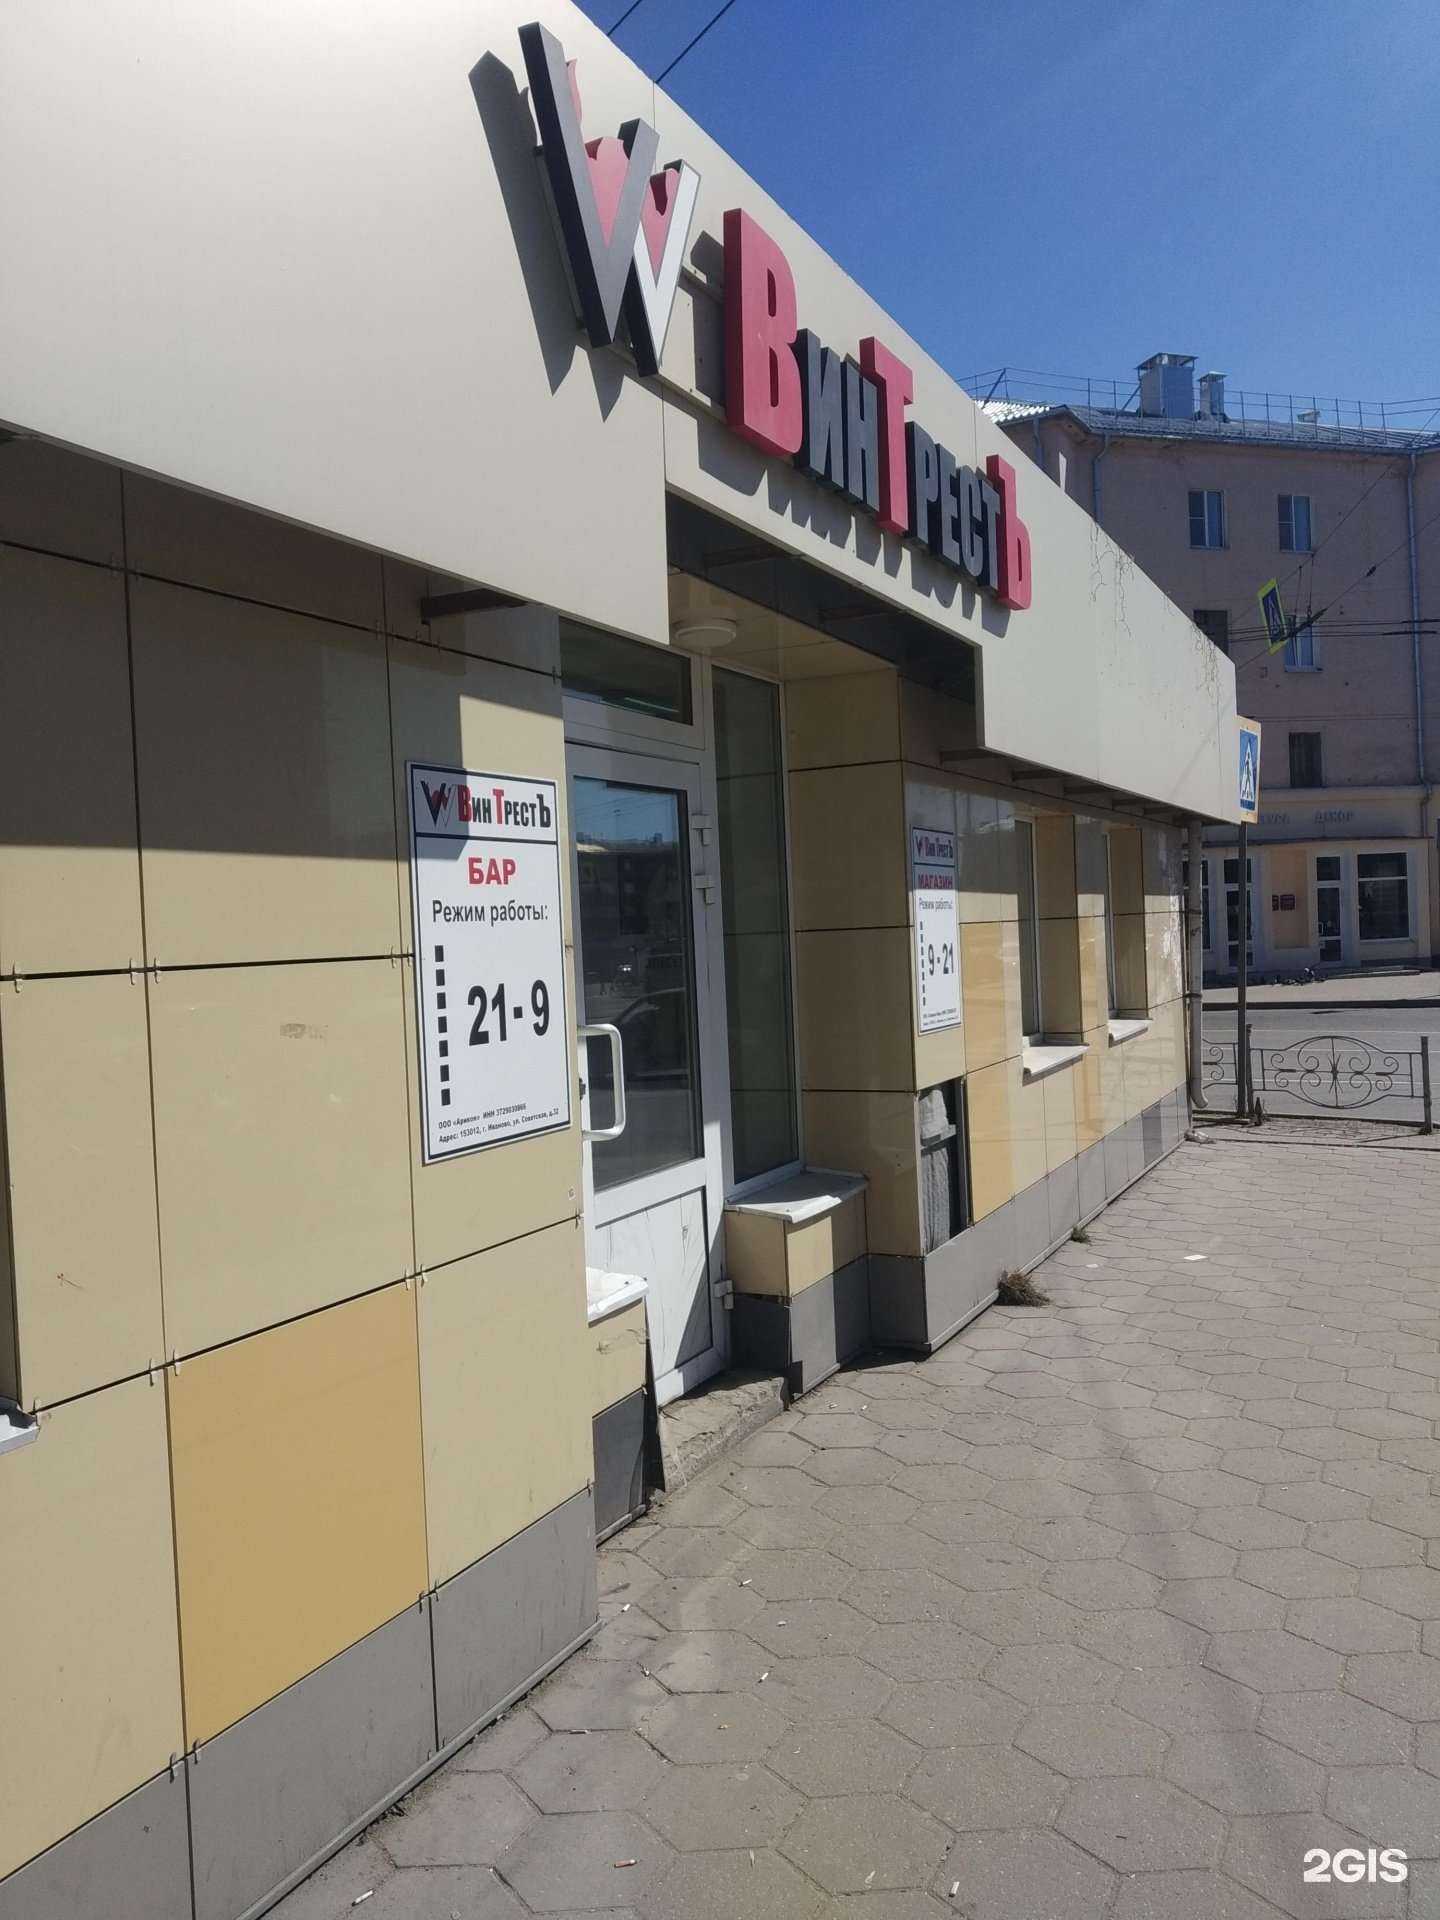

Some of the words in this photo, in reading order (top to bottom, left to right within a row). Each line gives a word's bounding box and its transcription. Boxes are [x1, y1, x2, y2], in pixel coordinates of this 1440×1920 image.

[468, 857, 516, 885] БАР
[918, 873, 953, 889] МАГАЗИН
[432, 900, 485, 922] Режим
[491, 900, 549, 926] работы:
[438, 1120, 452, 1129] ООО
[482, 1110, 495, 1120] ИНН
[438, 1132, 459, 1144] Адрес:
[460, 1126, 482, 1139] 153012,
